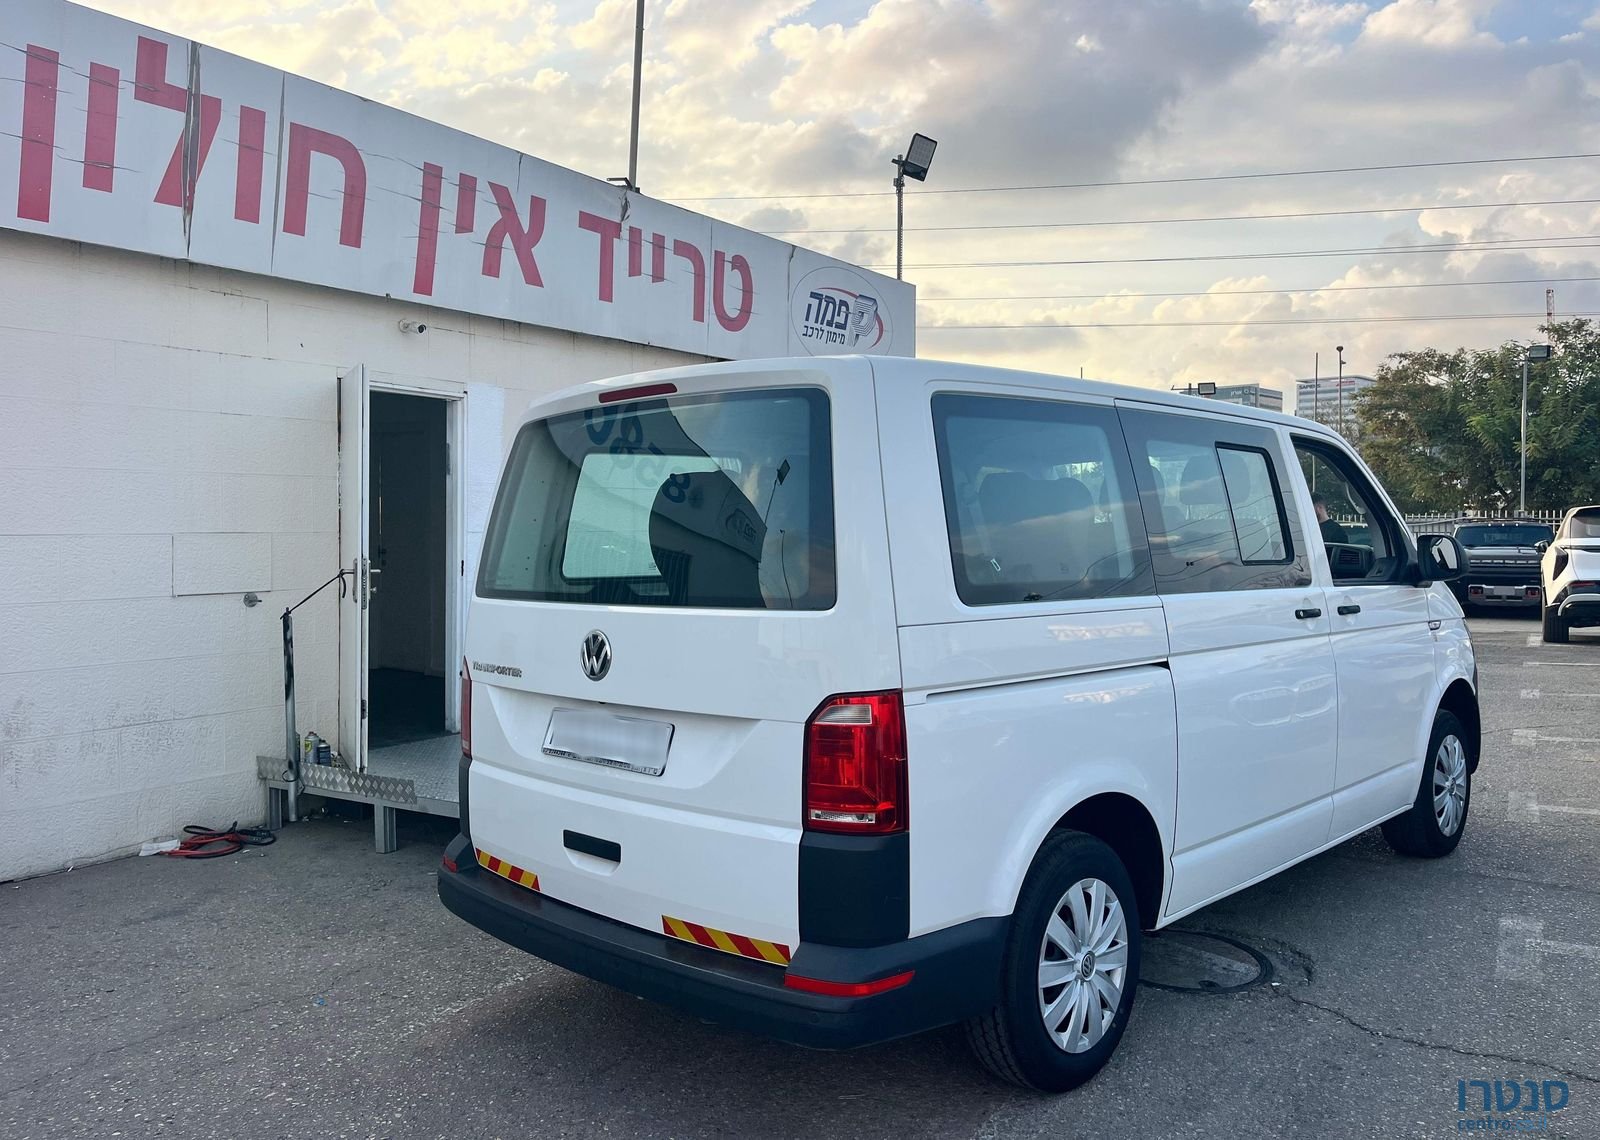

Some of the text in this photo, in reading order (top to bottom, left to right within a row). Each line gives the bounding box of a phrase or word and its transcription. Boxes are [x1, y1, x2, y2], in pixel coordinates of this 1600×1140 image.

[17, 36, 753, 332] טרייד אין חולון
[805, 291, 850, 331] פמה
[472, 660, 523, 678] TRANSPORTER
